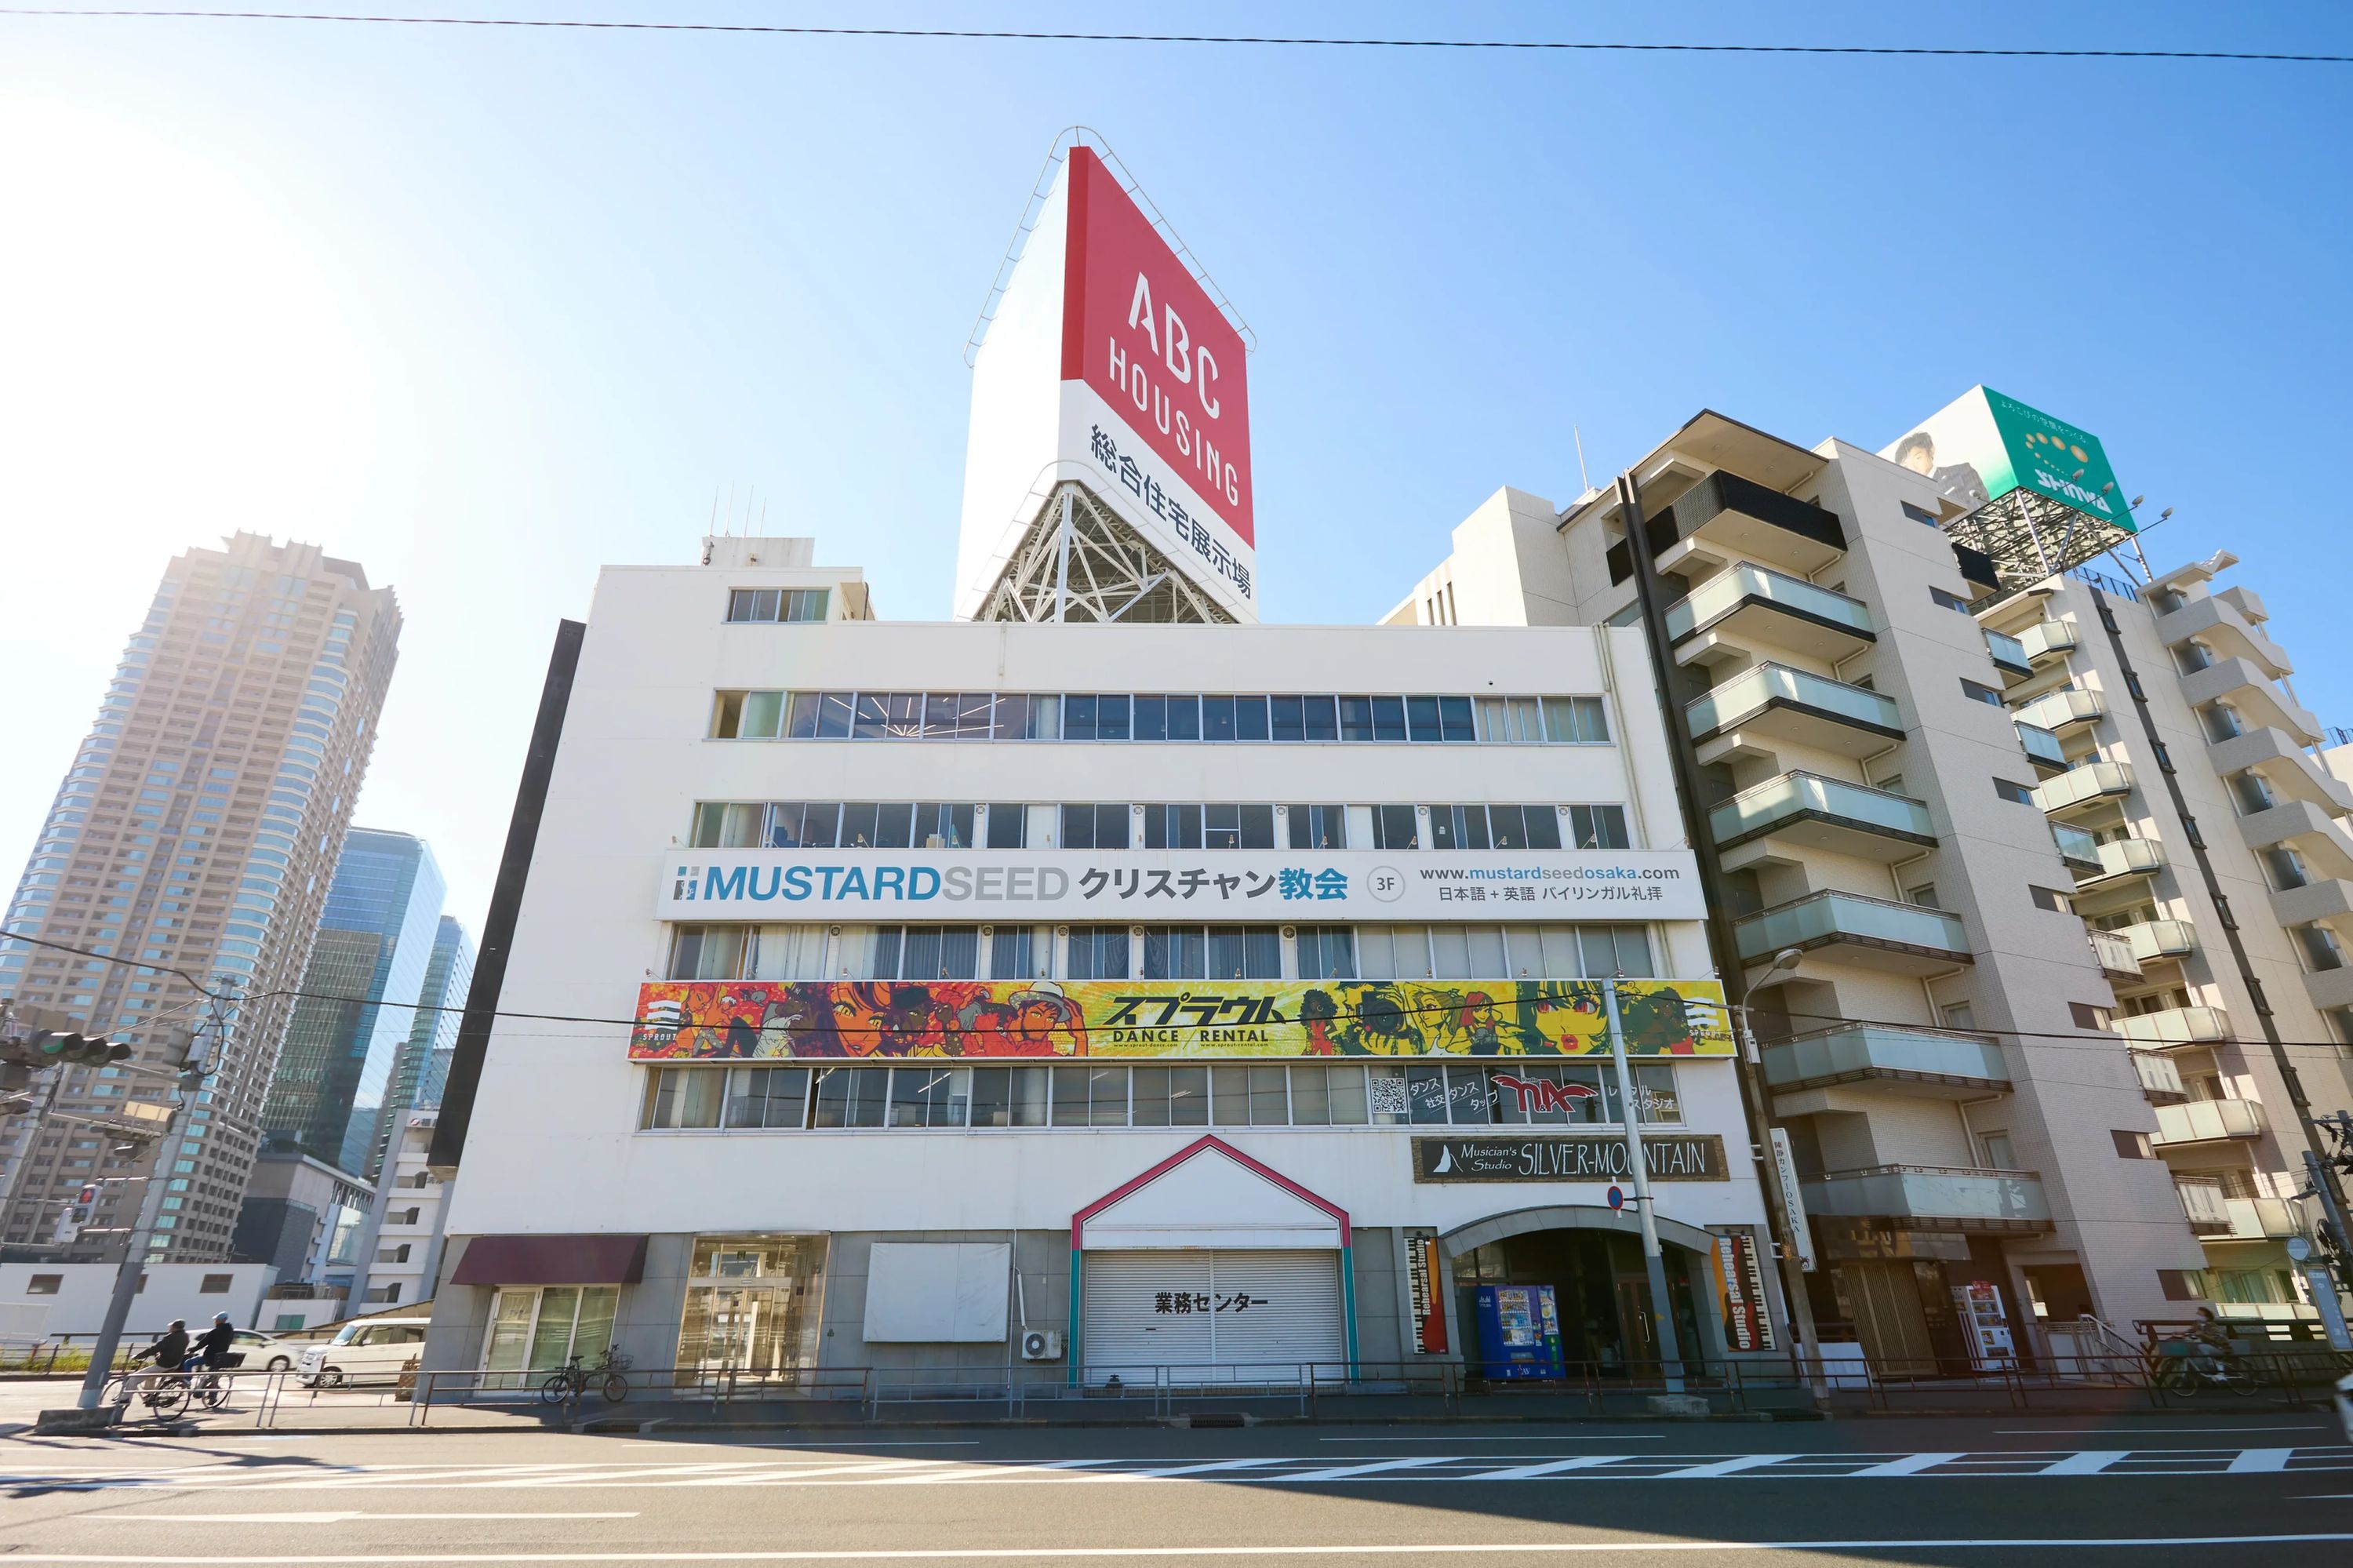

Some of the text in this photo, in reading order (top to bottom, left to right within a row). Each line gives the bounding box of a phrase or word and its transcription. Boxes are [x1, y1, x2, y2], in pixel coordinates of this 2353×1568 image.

[1129, 271, 1220, 419] ABC
[1110, 336, 1238, 507] HOUSING
[1091, 424, 1251, 601] 総合住宅展示場
[1420, 866, 1679, 879] www.mustardseedosaka.com
[704, 865, 1348, 901] MUSTARDSEED クリスチャン教会
[1377, 877, 1395, 891] 3F
[1438, 886, 1486, 901] 日本語
[1504, 886, 1535, 901] 英語
[1543, 886, 1663, 901] バイリンガル礼拝
[1103, 991, 1286, 1025] スプラウト
[1113, 1030, 1268, 1042] DANCE RENTAL
[1410, 1077, 1441, 1096] ダンス
[1608, 1085, 1652, 1097] レタル
[1471, 1090, 1502, 1111] タップ
[1633, 1098, 1675, 1110] スタジオ
[1460, 1144, 1517, 1159] Musician's
[1471, 1159, 1512, 1172] Studio
[1417, 1239, 1431, 1315] Rehearsal Studio
[1155, 1292, 1268, 1314] 業務センター
[1718, 1237, 1751, 1349] Rehearsal Studio
